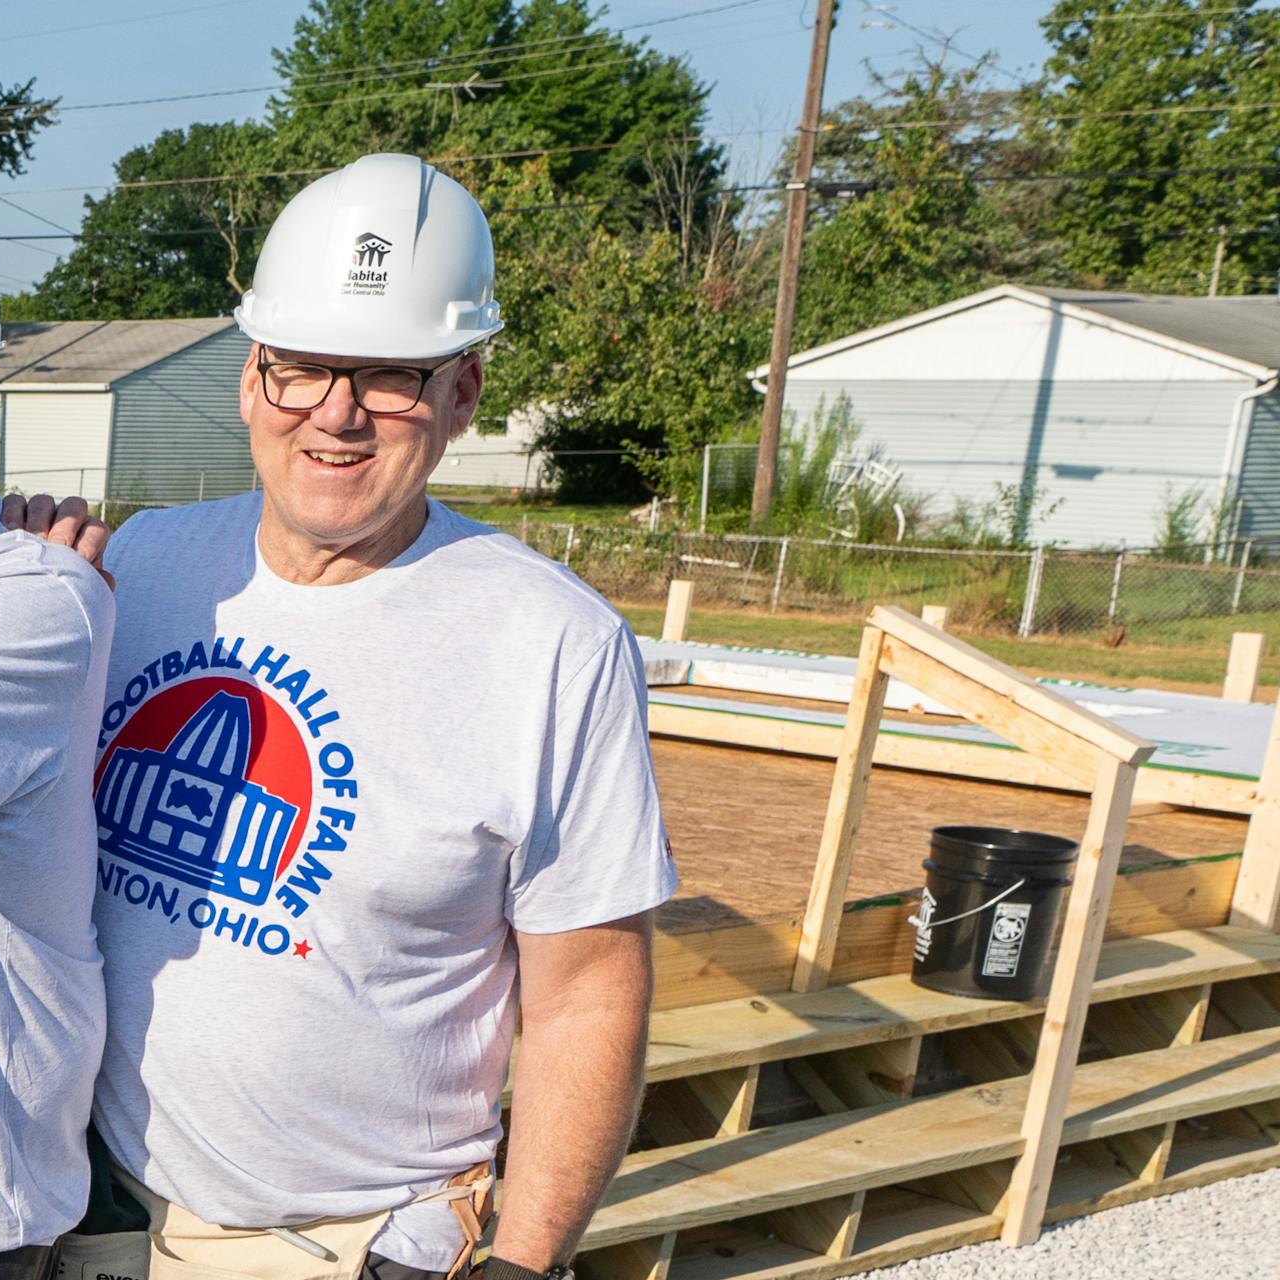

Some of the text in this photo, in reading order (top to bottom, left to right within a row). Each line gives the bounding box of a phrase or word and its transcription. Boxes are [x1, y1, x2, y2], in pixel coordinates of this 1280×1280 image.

[248, 645, 340, 738] HALL
[318, 742, 358, 798] OF
[98, 857, 290, 956] NTON, OHIO
[275, 806, 356, 918] FAME
